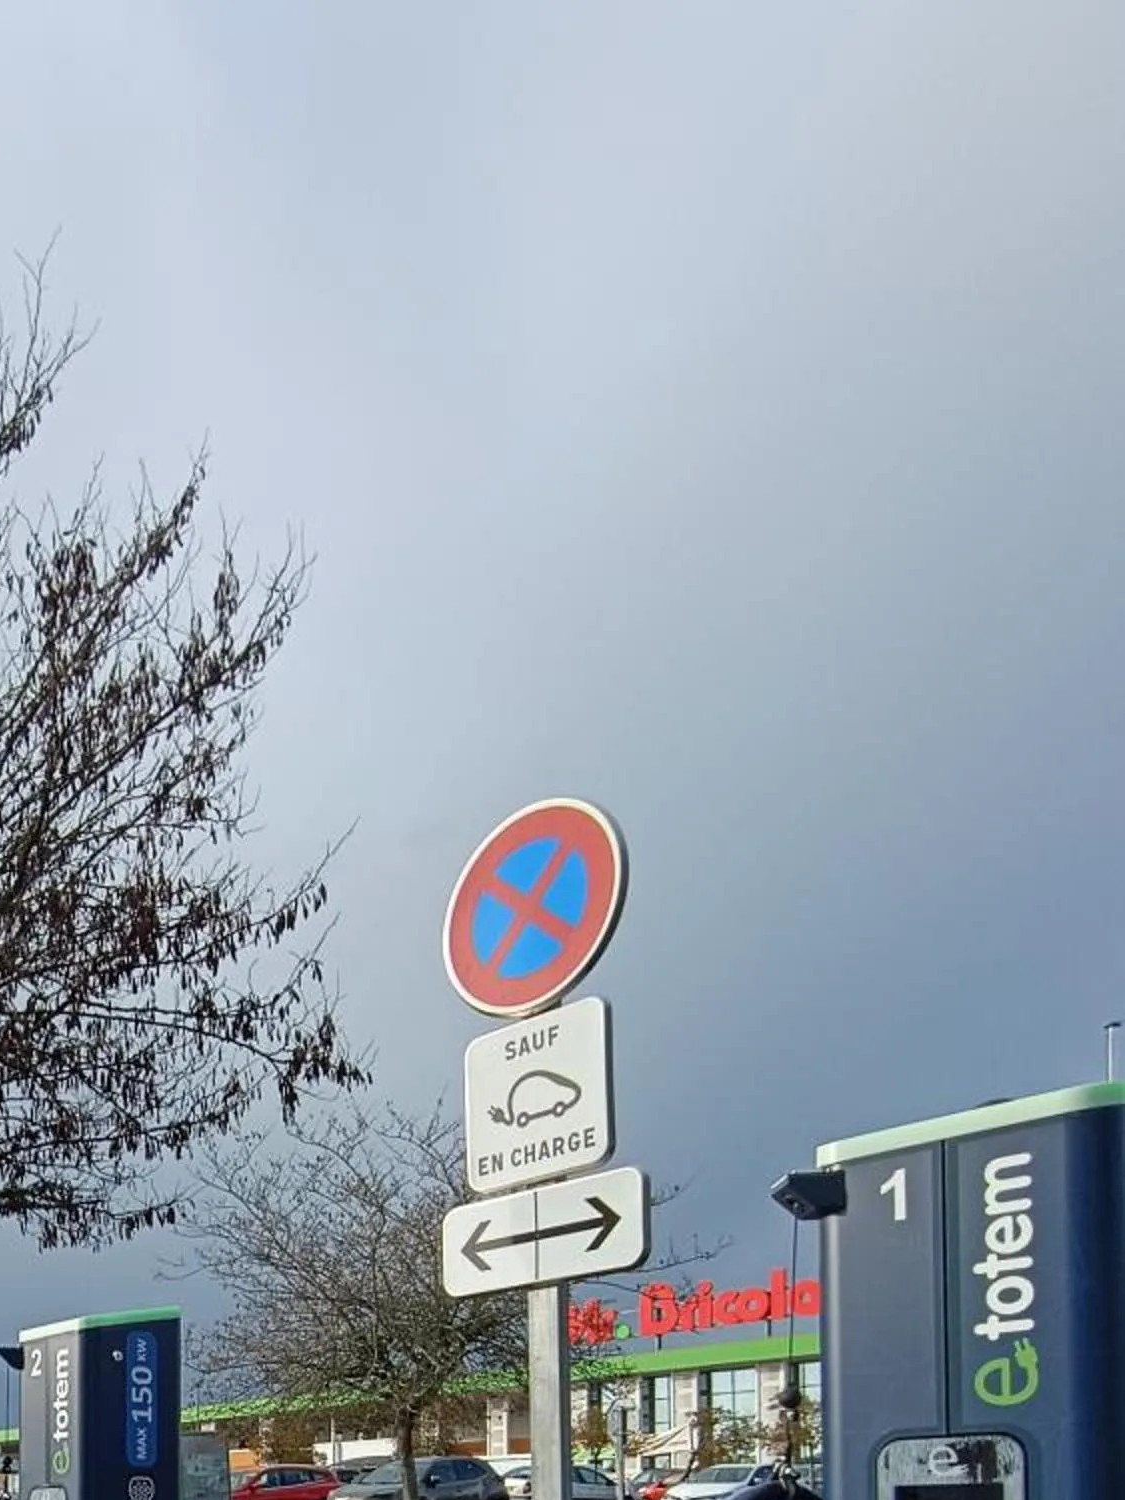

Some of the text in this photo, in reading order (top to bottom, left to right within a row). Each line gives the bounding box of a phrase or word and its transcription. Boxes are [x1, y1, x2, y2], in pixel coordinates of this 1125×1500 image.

[504, 1024, 560, 1061] SAUF
[478, 1126, 596, 1177] EN CHARGE
[880, 1168, 907, 1221] 1
[30, 1348, 42, 1377] 2
[131, 1365, 153, 1424] 150
[136, 1426, 148, 1460] MAX
